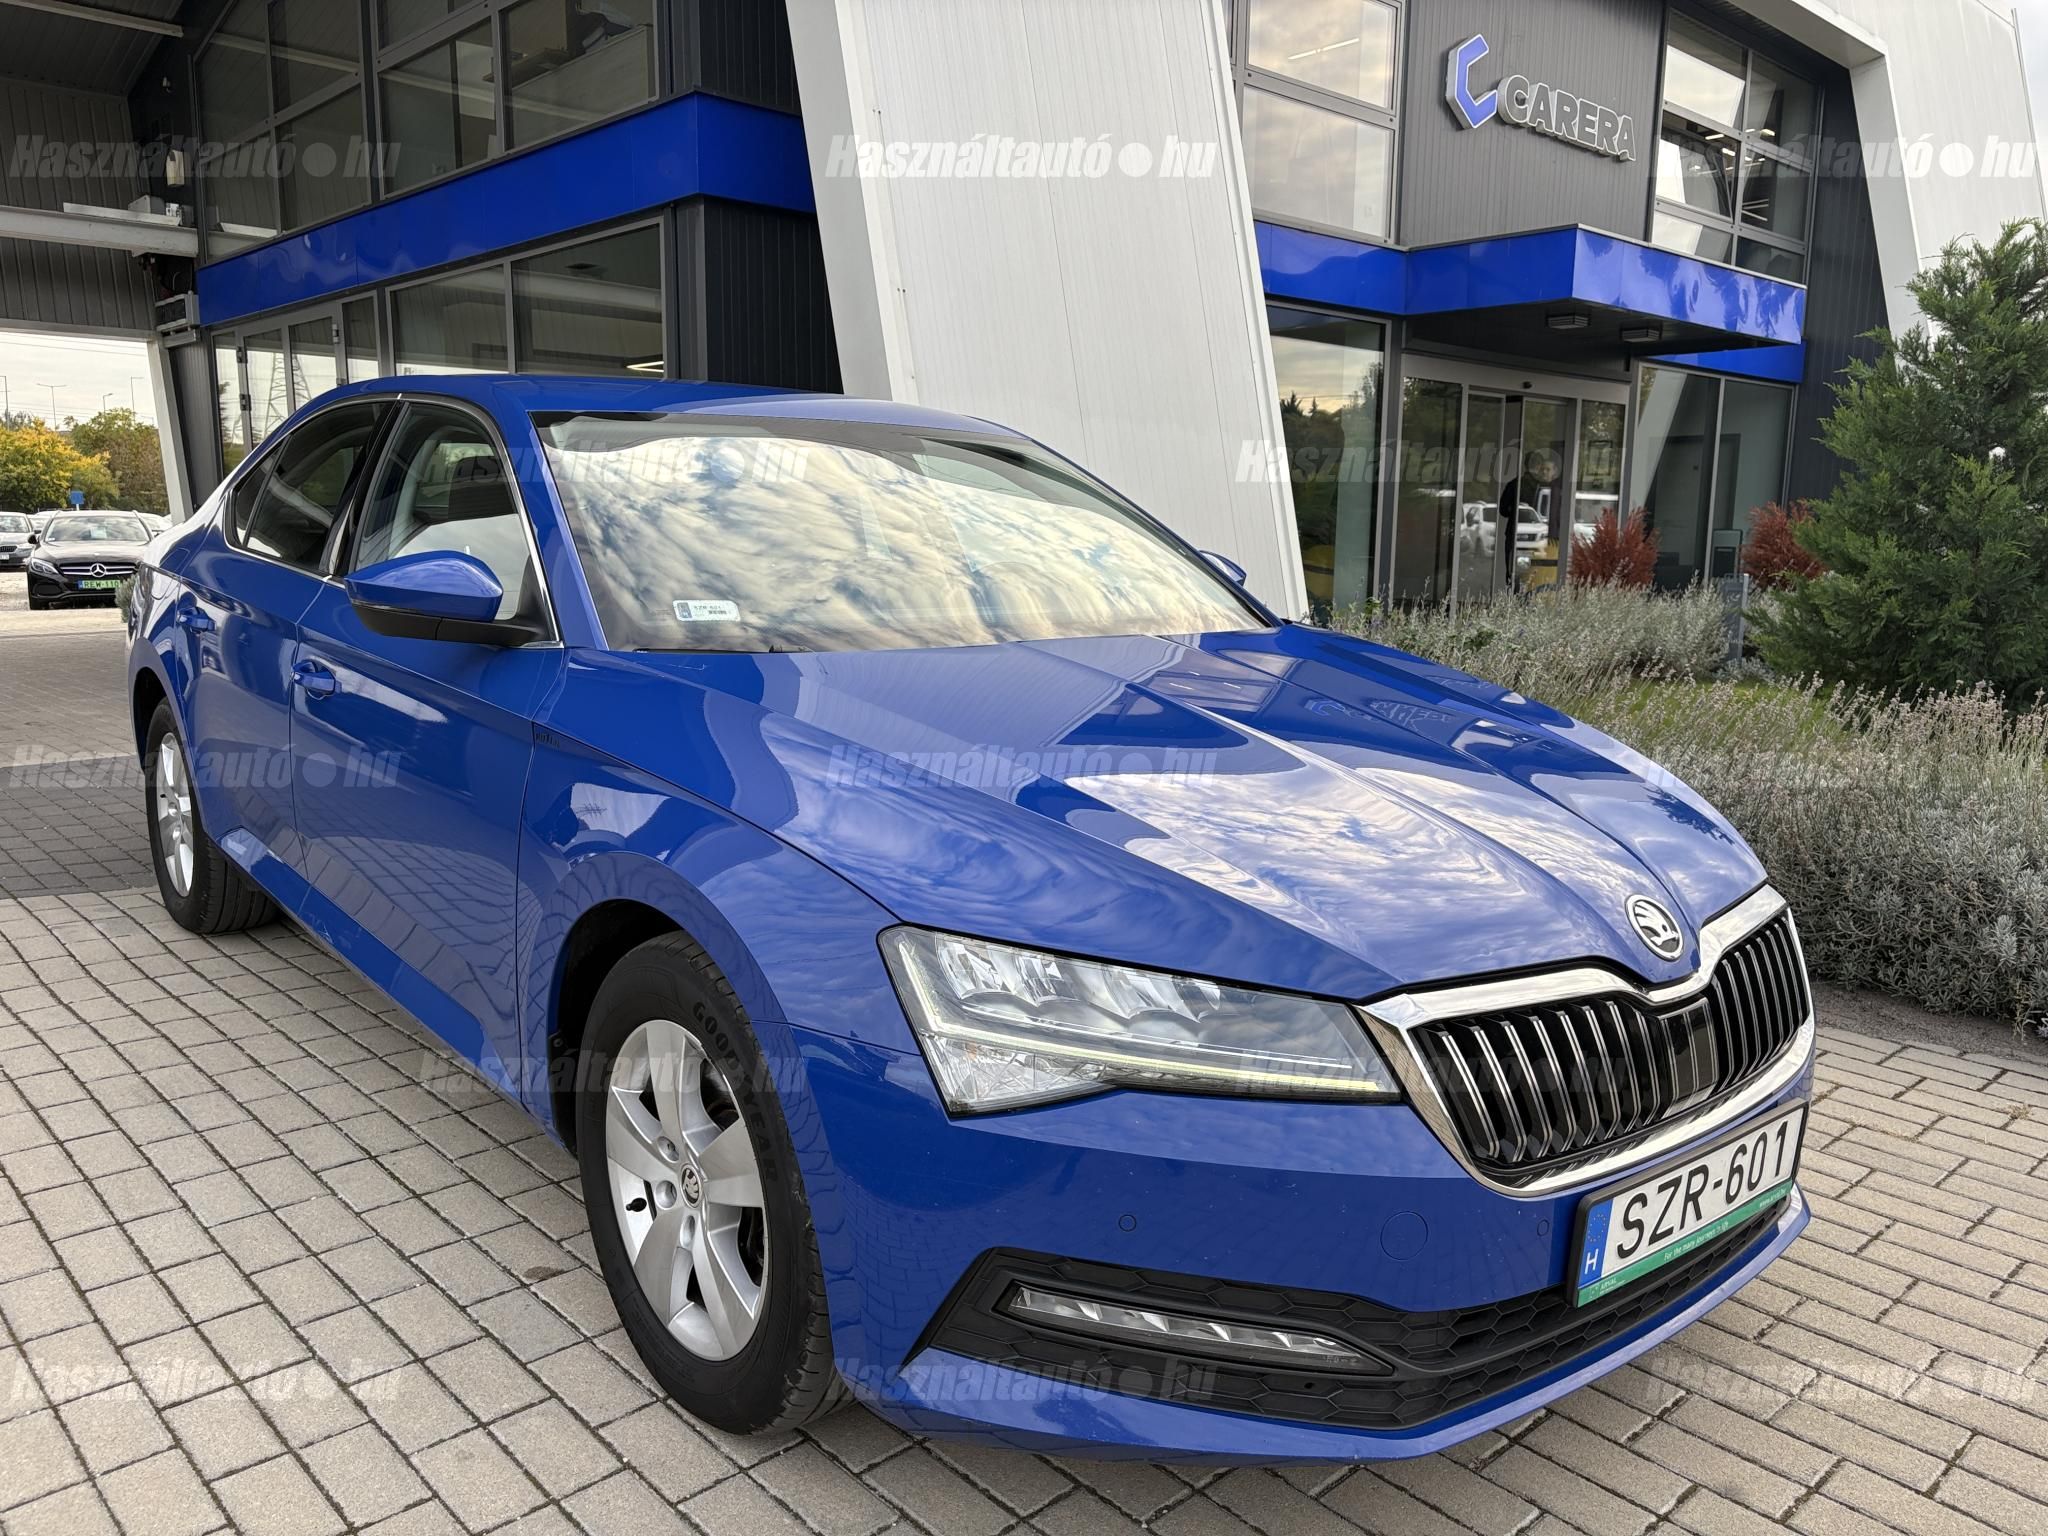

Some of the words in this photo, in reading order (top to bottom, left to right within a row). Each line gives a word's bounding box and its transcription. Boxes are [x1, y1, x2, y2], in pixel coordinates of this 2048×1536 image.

[1499, 74, 1636, 161] CARERA
[1617, 1120, 1788, 1259] SZR-601
[1584, 1248, 1599, 1276] H
